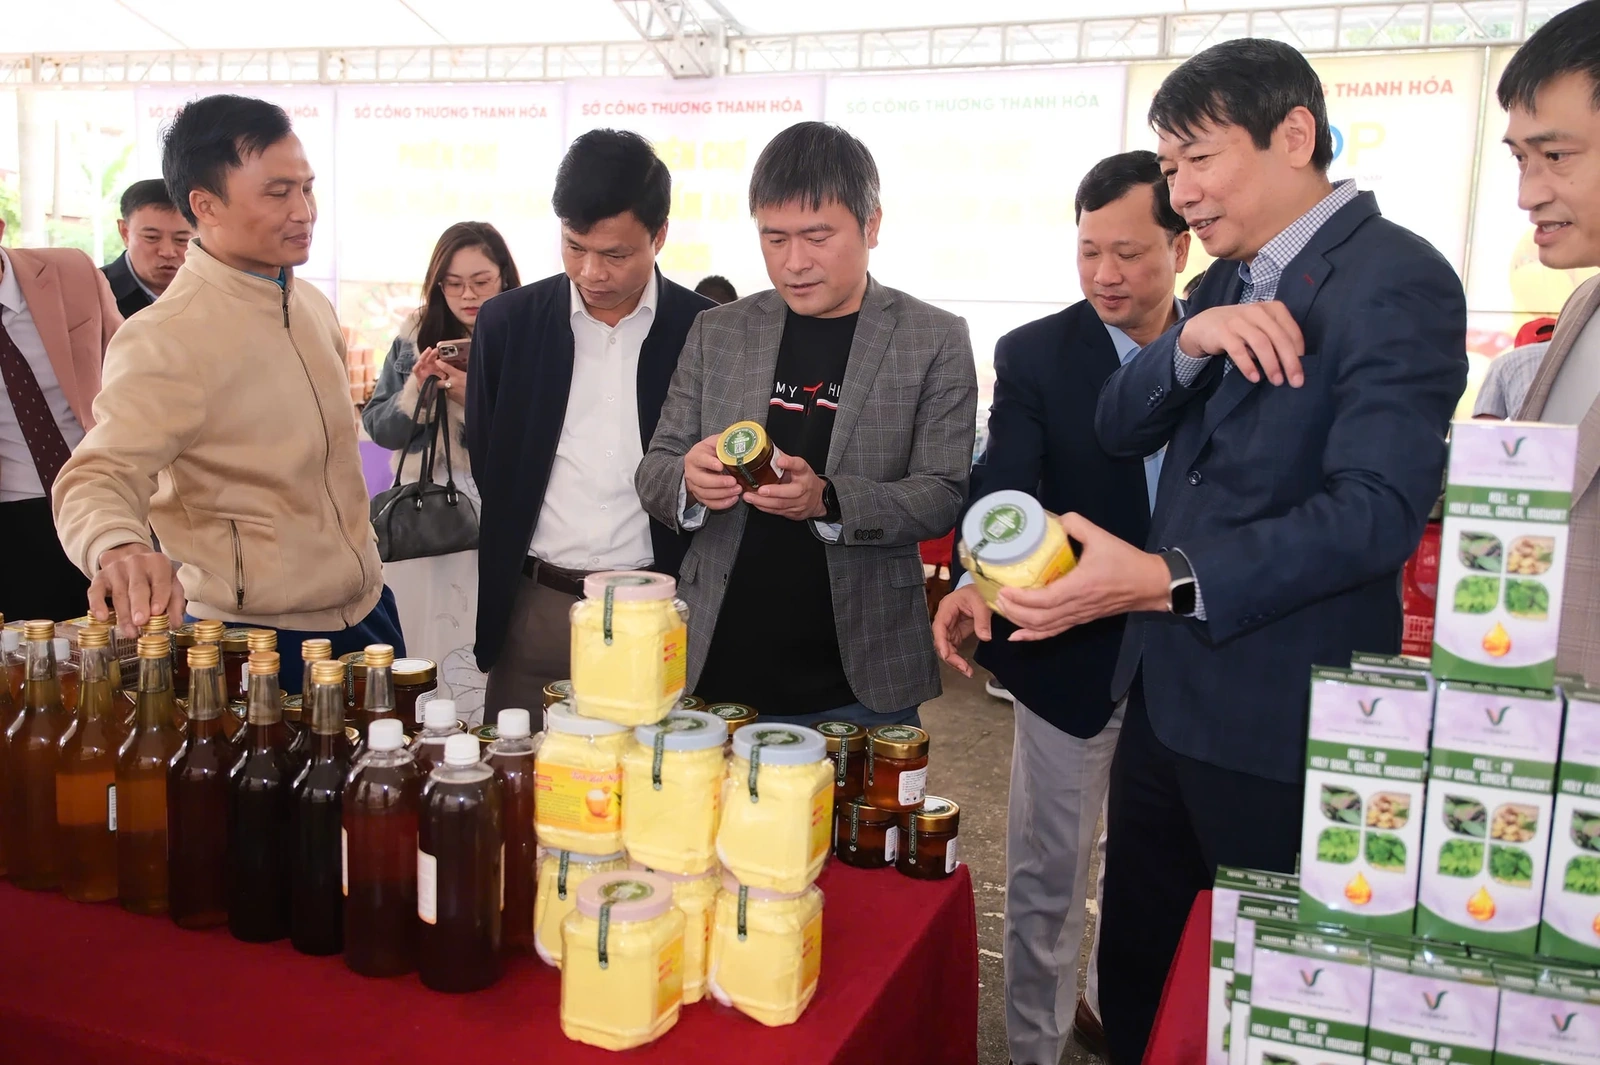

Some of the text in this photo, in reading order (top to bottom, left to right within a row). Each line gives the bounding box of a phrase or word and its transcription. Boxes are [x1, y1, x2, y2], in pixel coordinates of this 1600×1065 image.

[1334, 80, 1403, 97] THANH
[1408, 75, 1453, 95] HÓA
[374, 103, 412, 119] CÔNG
[472, 106, 515, 118] THANH
[519, 103, 548, 119] HÓA
[605, 99, 647, 115] CÔNG
[717, 99, 767, 113] THANH
[770, 95, 804, 113] HÓA
[872, 98, 920, 113] CÔNG
[1000, 95, 1056, 111] THANH
[1062, 91, 1100, 109] HÓA
